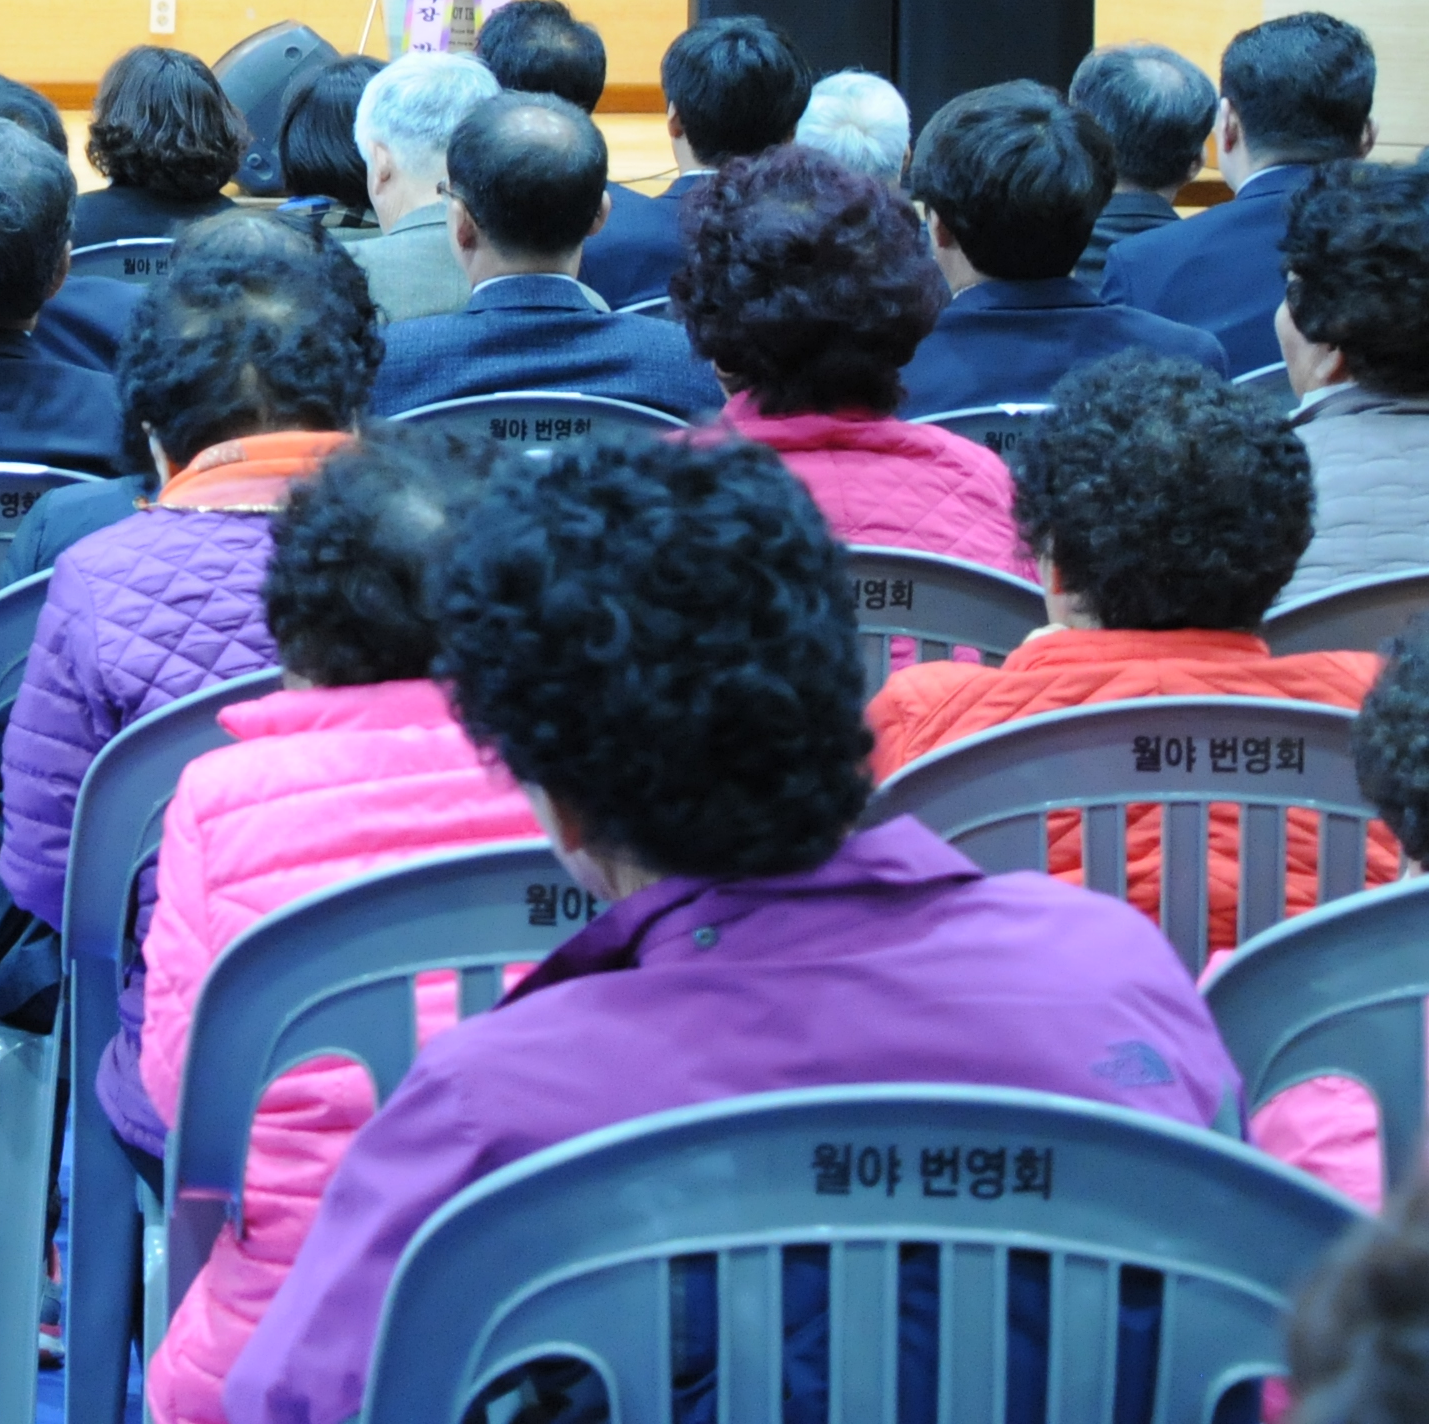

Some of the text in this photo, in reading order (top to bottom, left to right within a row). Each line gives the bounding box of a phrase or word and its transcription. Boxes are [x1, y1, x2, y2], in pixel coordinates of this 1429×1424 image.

[854, 579, 913, 611] 영회
[1131, 735, 1306, 775] 월야 번영회
[811, 1142, 1054, 1201] 월야 번영회
